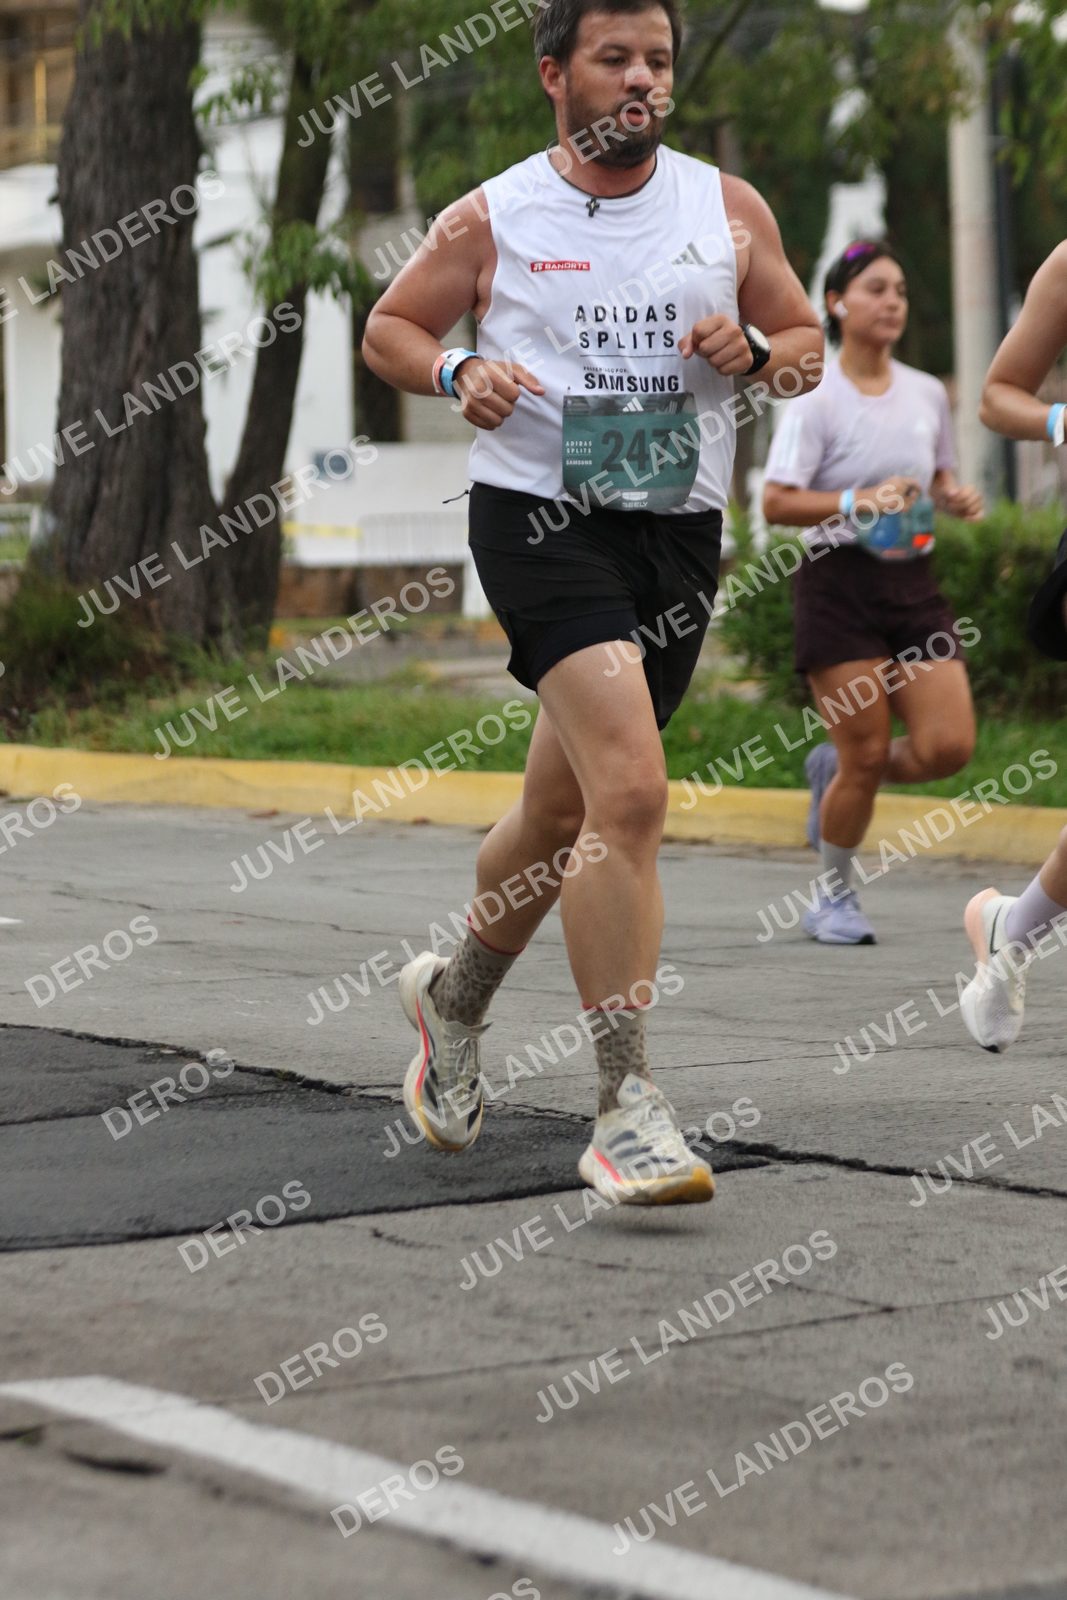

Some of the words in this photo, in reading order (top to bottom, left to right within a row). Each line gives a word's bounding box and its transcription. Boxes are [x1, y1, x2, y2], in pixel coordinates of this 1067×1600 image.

[544, 262, 589, 270] BANORTE
[575, 303, 677, 323] ADIDAS
[579, 330, 675, 350] SPLITS
[584, 372, 679, 393] SAMSUNG
